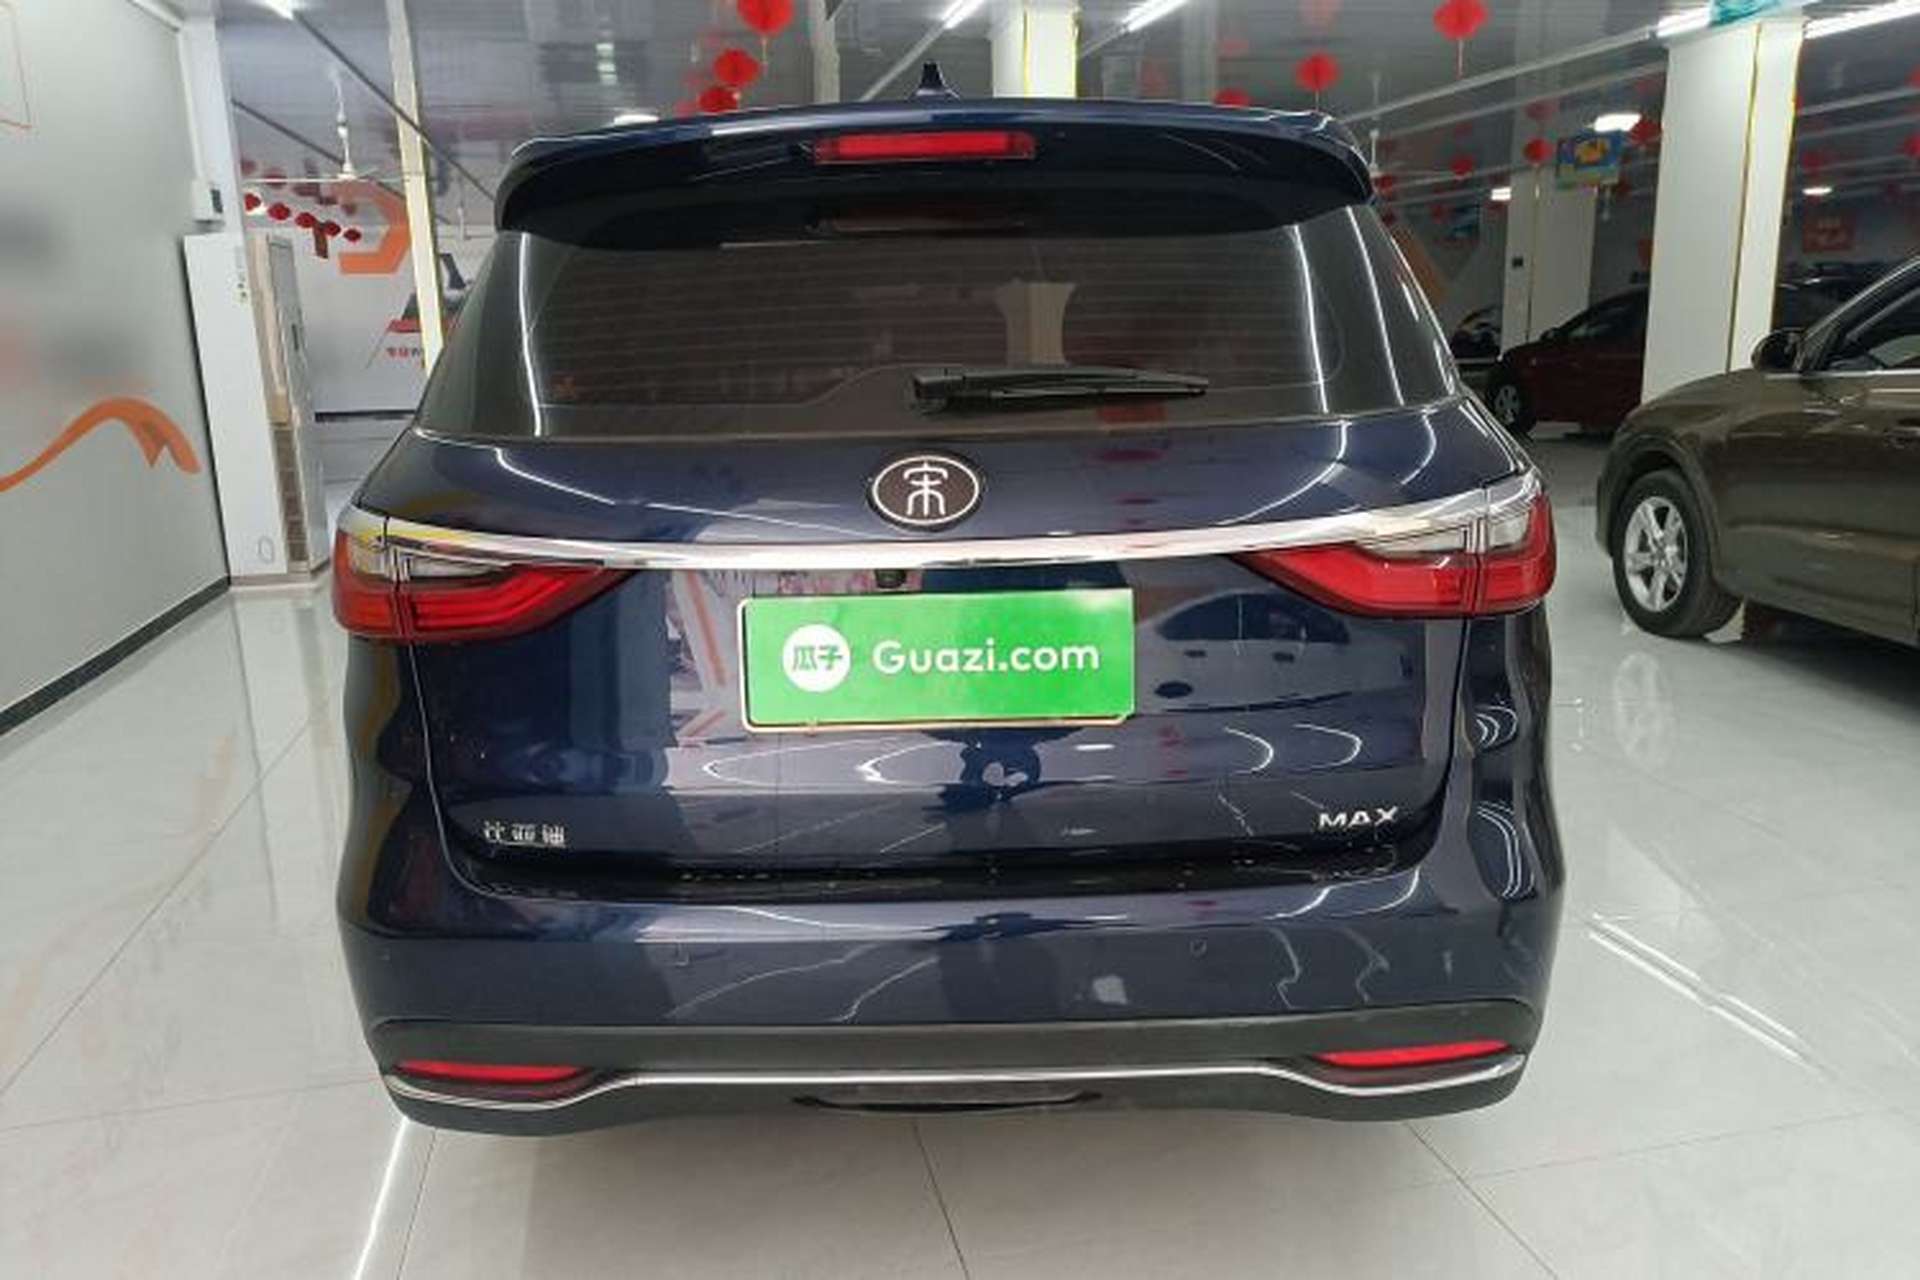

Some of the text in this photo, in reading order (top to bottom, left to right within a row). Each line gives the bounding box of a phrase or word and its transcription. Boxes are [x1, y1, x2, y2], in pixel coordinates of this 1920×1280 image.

[792, 644, 843, 671] 瓜子
[872, 638, 1100, 674] Guazi.com
[1318, 805, 1398, 831] MAX
